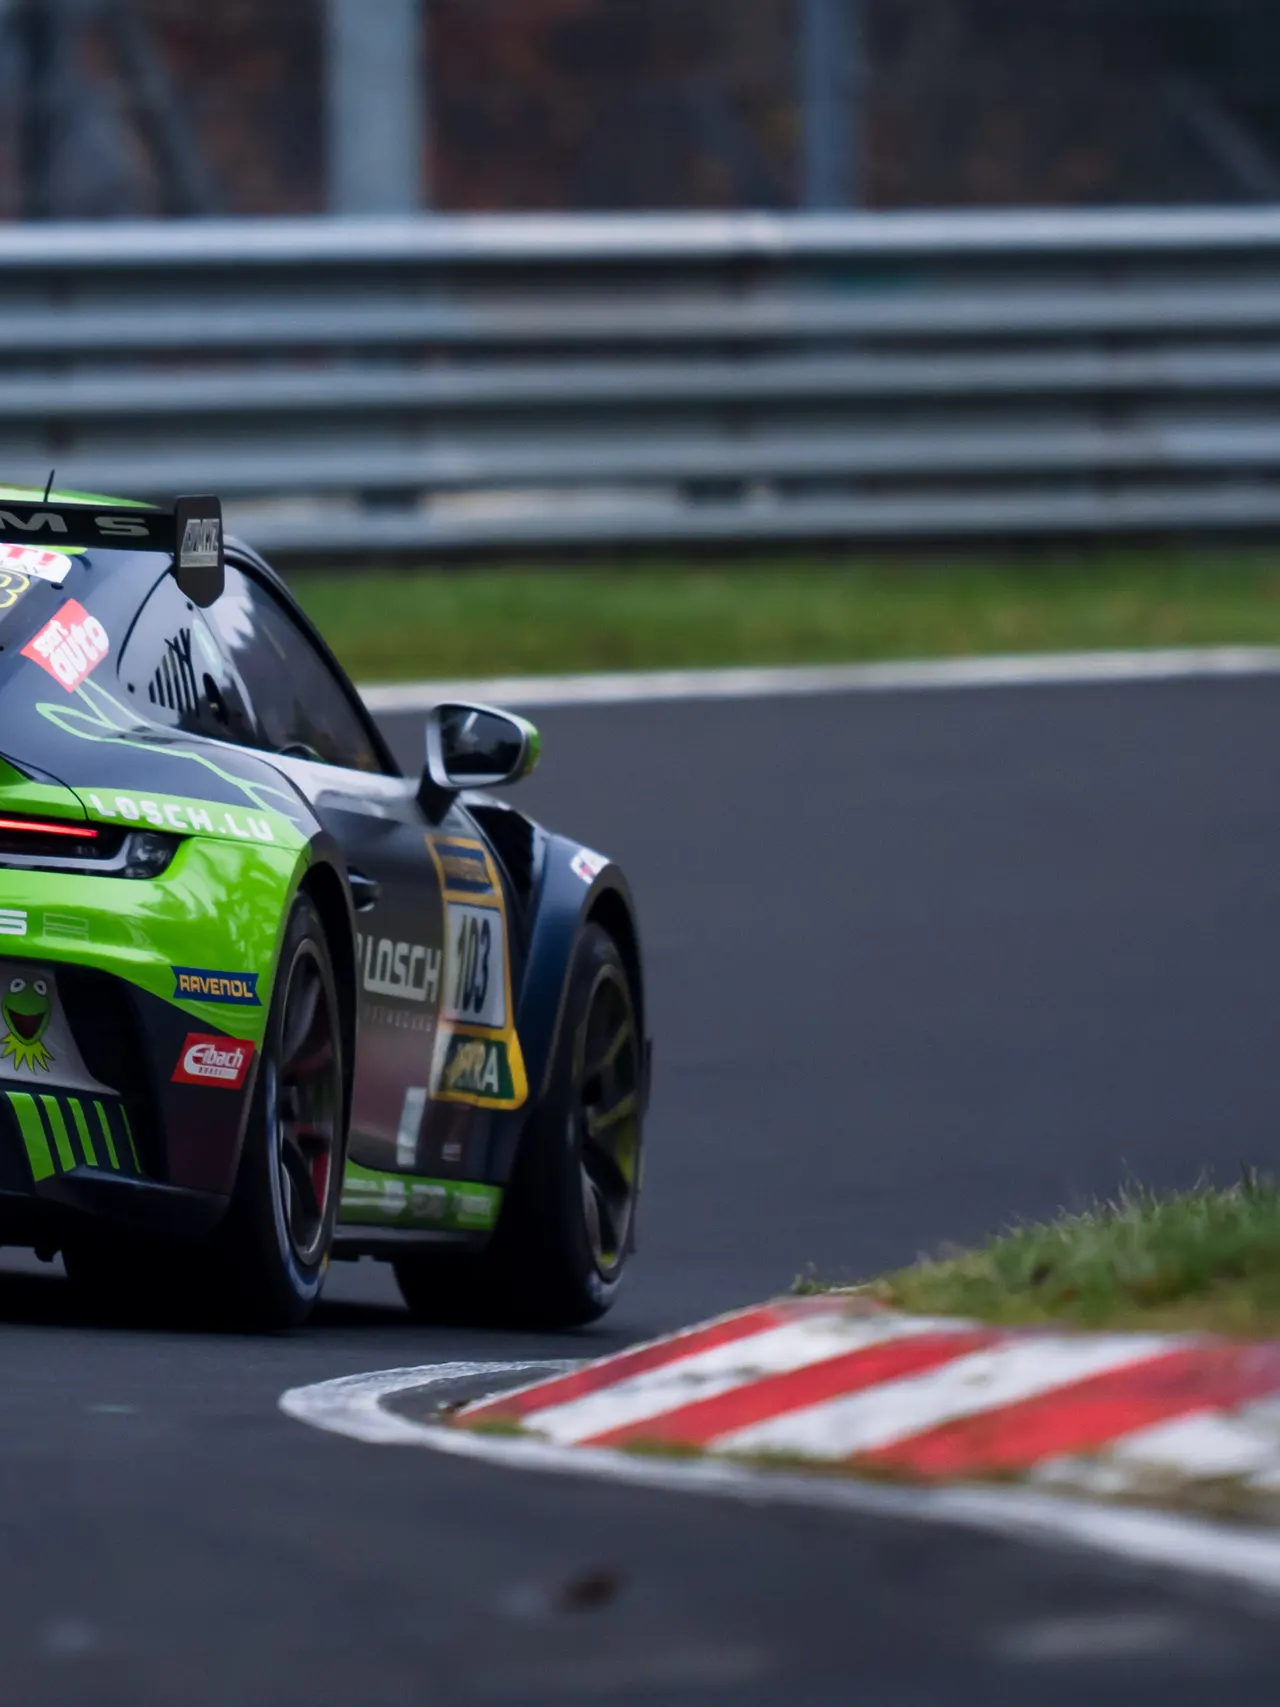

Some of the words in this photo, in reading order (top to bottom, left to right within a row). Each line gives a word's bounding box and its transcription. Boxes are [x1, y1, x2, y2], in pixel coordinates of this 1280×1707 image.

[49, 615, 110, 685] auto
[90, 794, 274, 841] LOSCH.LU
[179, 974, 253, 998] RAVENOL
[363, 935, 442, 1003] LOSCH
[456, 914, 491, 1014] 103
[184, 1043, 244, 1080] Eibach
